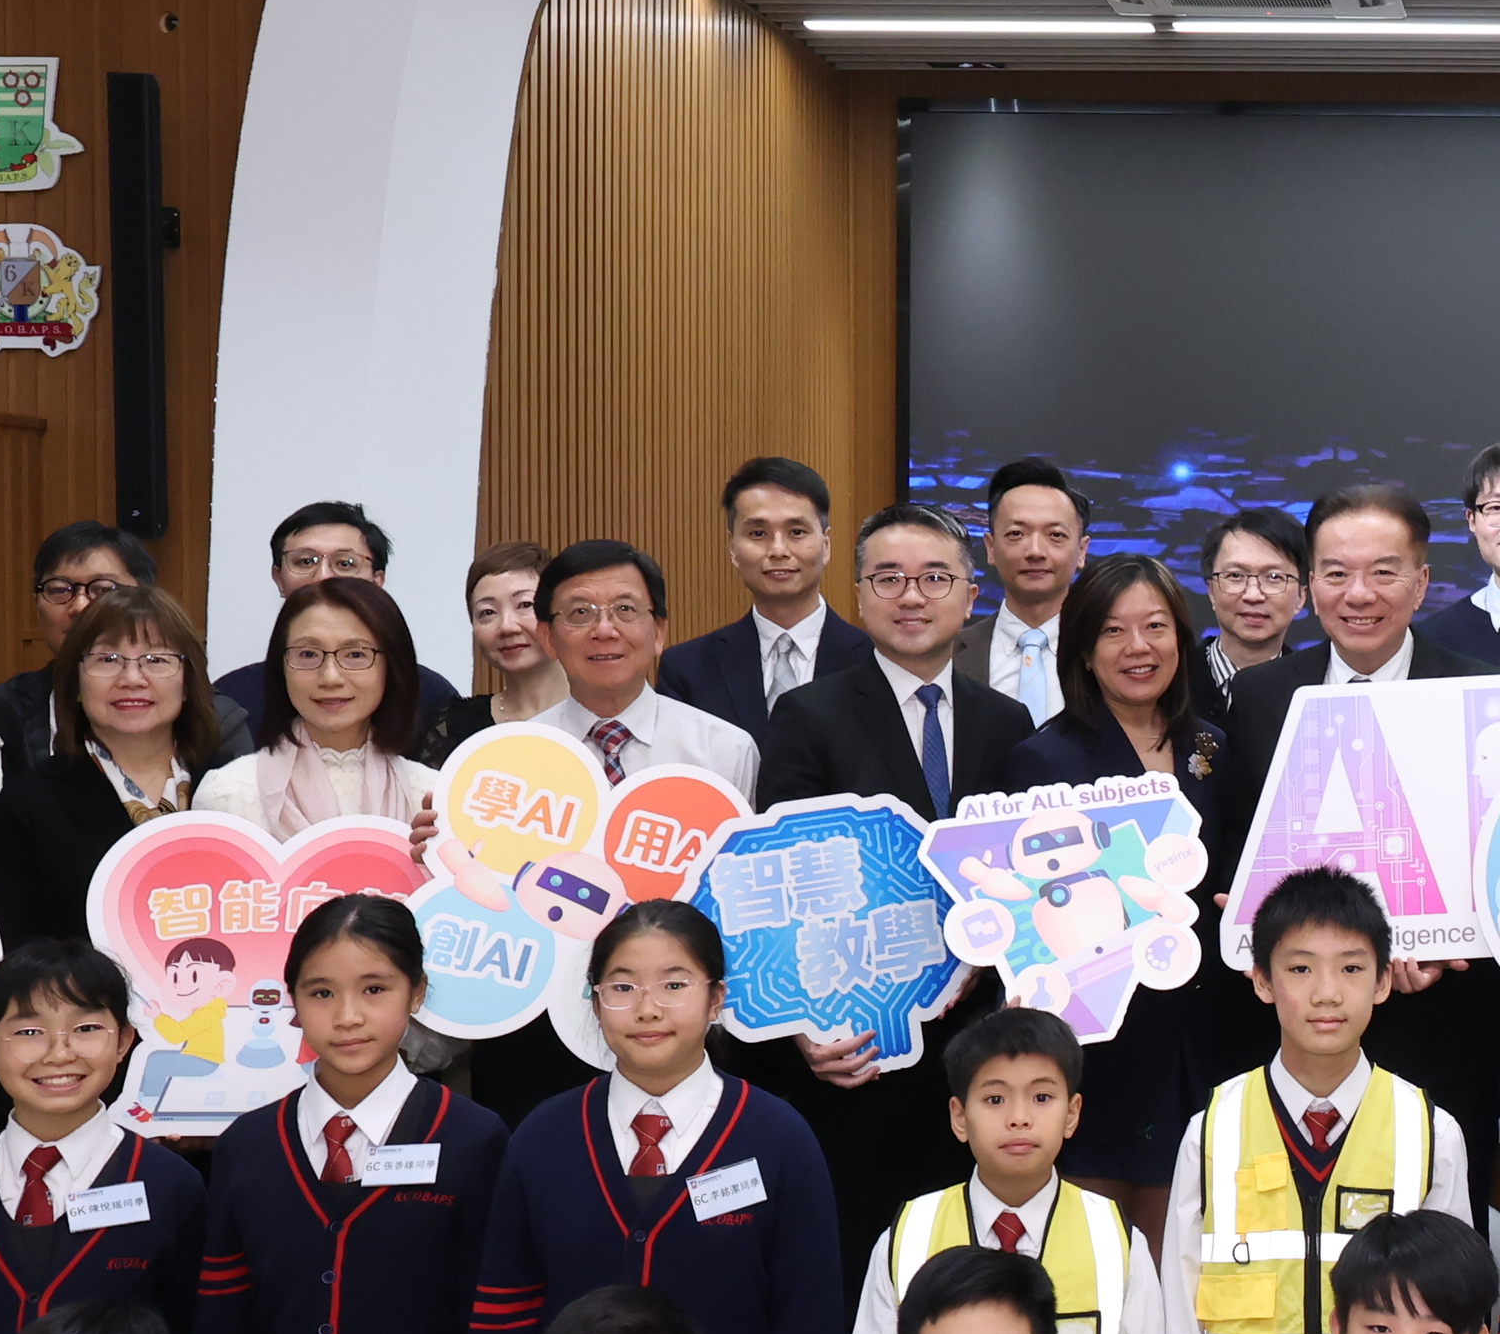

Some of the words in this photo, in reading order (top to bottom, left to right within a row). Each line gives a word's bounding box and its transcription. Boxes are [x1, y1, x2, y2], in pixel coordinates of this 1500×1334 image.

[8, 120, 35, 146] K
[4, 265, 17, 282] 6
[21, 281, 35, 297] K
[464, 775, 577, 839] 學AI
[964, 801, 985, 820] AI
[992, 799, 1024, 815] for
[1031, 790, 1073, 811] ALL
[1079, 778, 1171, 805] subjects
[621, 815, 702, 868] 用A
[715, 841, 864, 932] 智慧
[423, 919, 533, 983] 創AI
[799, 902, 945, 995] 教學
[366, 1161, 380, 1172] 6C
[69, 1205, 87, 1218] 6K
[693, 1194, 709, 1206] 6C
